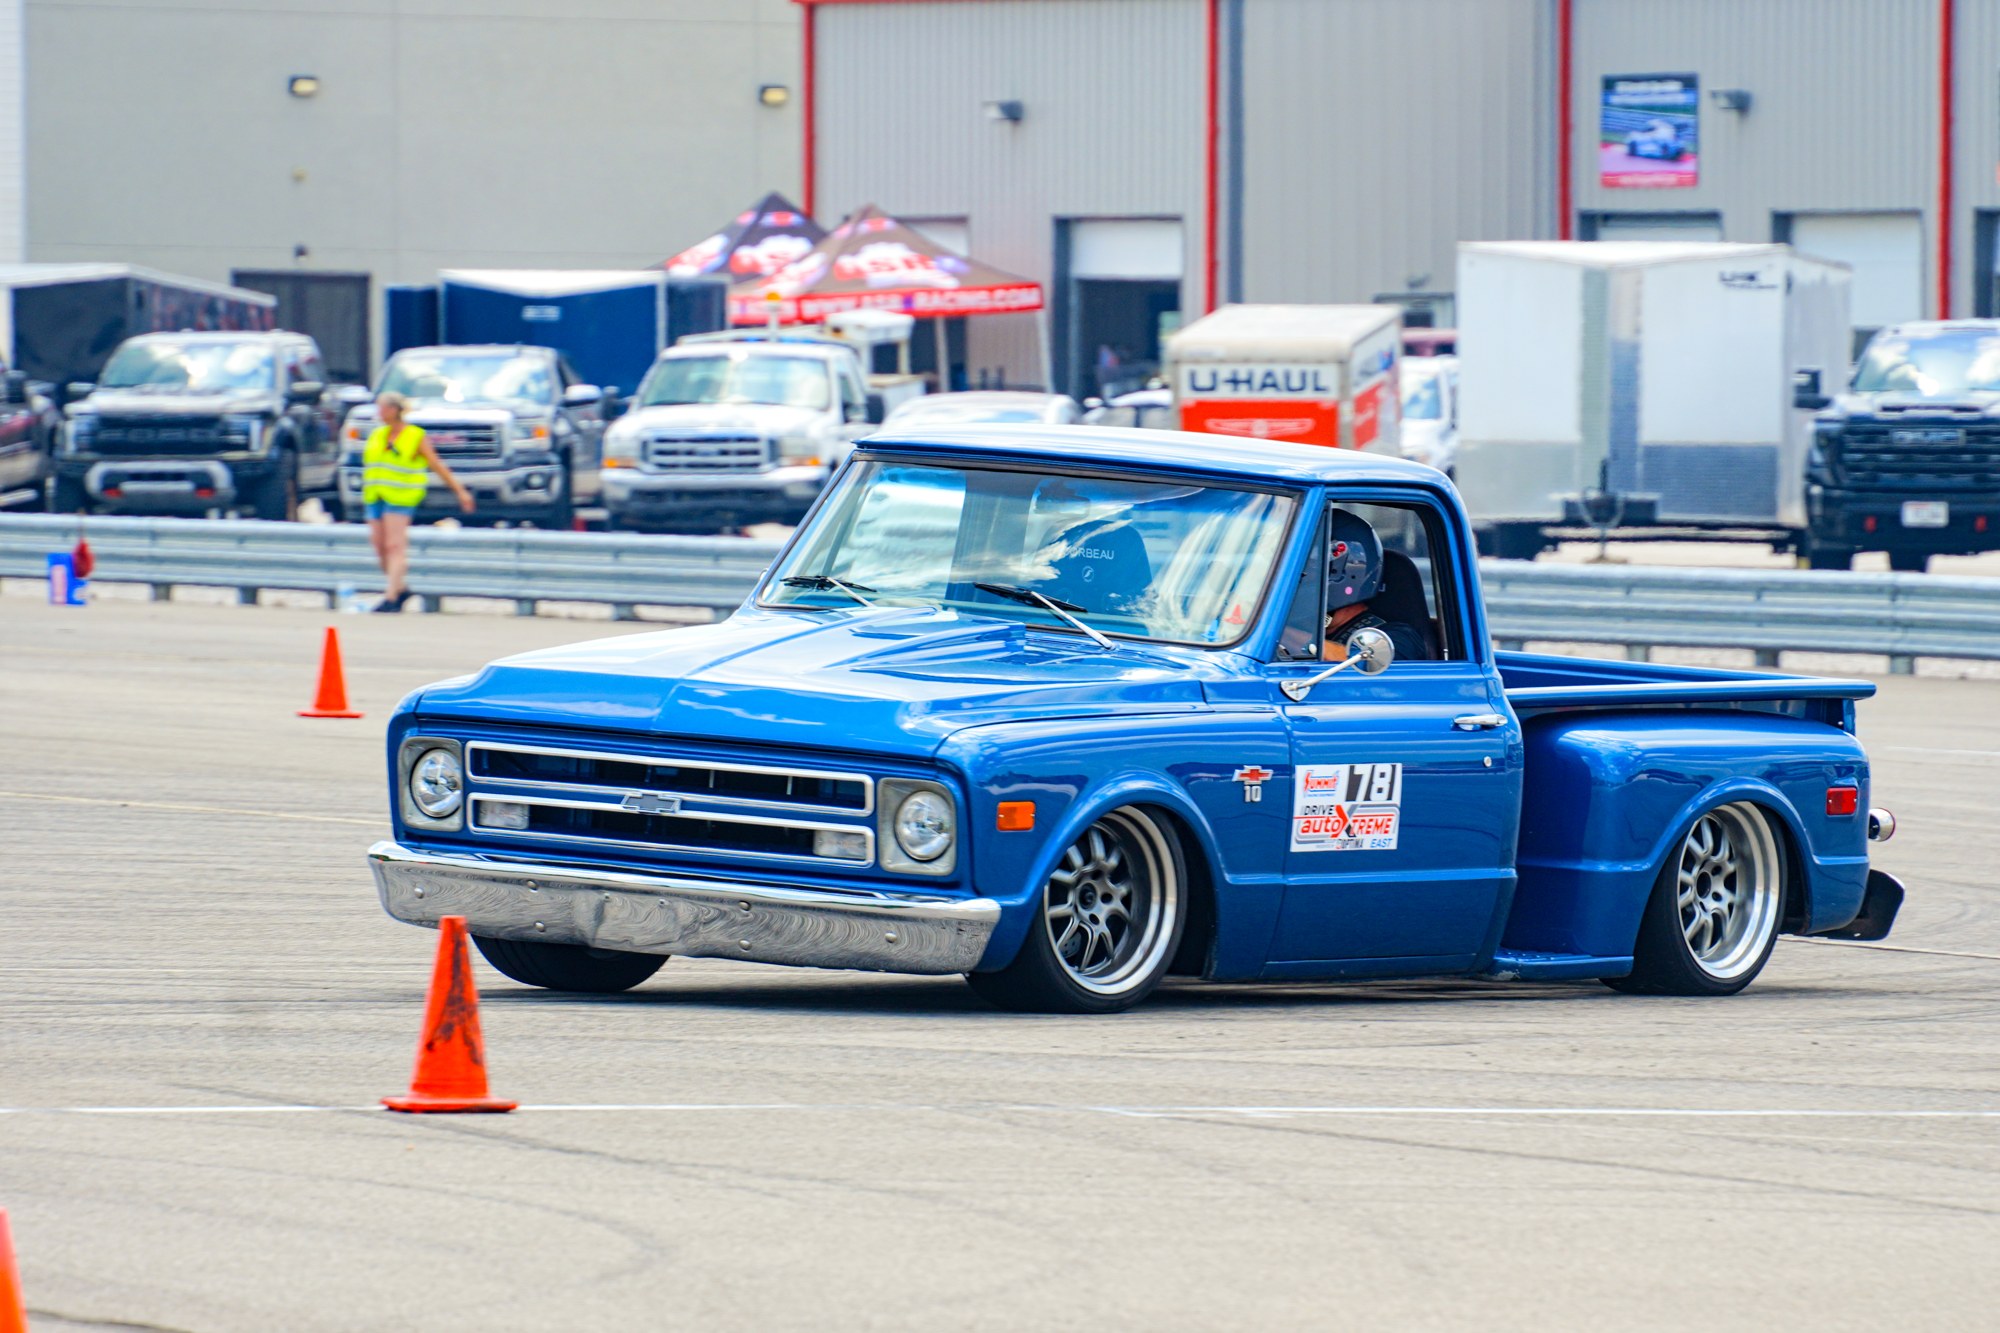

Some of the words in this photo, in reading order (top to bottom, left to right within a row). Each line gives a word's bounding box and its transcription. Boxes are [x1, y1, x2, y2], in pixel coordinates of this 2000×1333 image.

[1189, 369, 1329, 393] U-HAUL
[1244, 785, 1262, 802] 10
[1304, 804, 1335, 816] DRIVE
[1370, 838, 1393, 849] EAST
